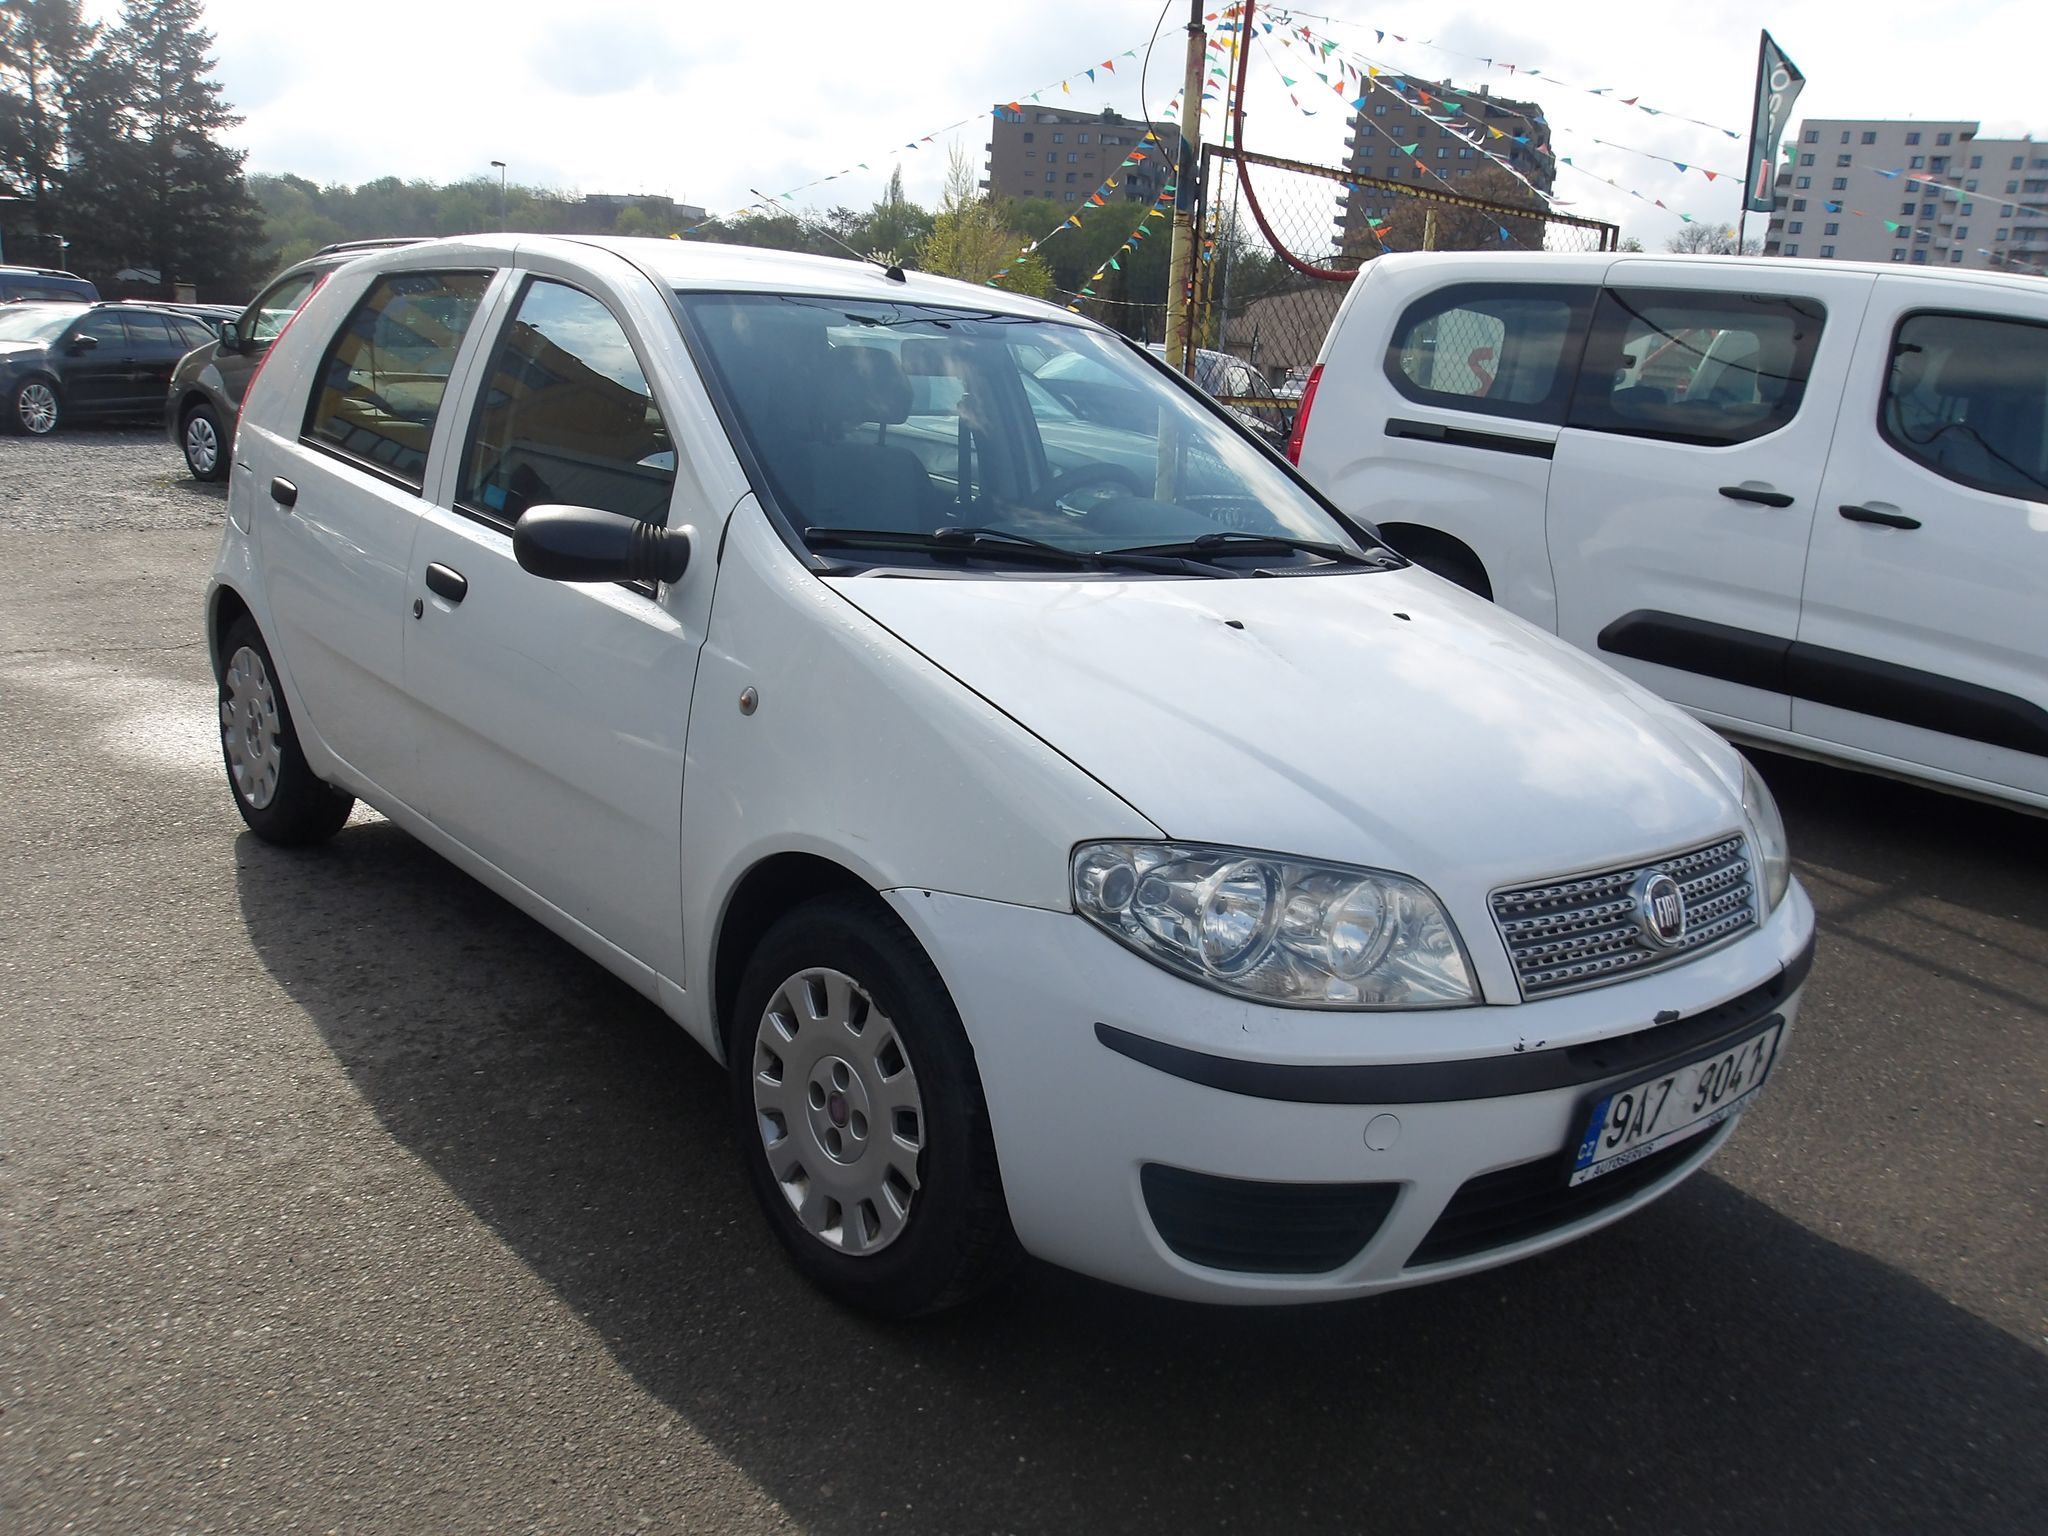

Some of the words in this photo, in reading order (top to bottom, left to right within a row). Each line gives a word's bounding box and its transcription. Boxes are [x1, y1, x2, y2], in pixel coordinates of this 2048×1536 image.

[1655, 894, 1680, 928] FIAT
[1606, 1077, 1675, 1149] 9A7
[1692, 1035, 1767, 1114] 9041
[1577, 1141, 1596, 1161] CZ
